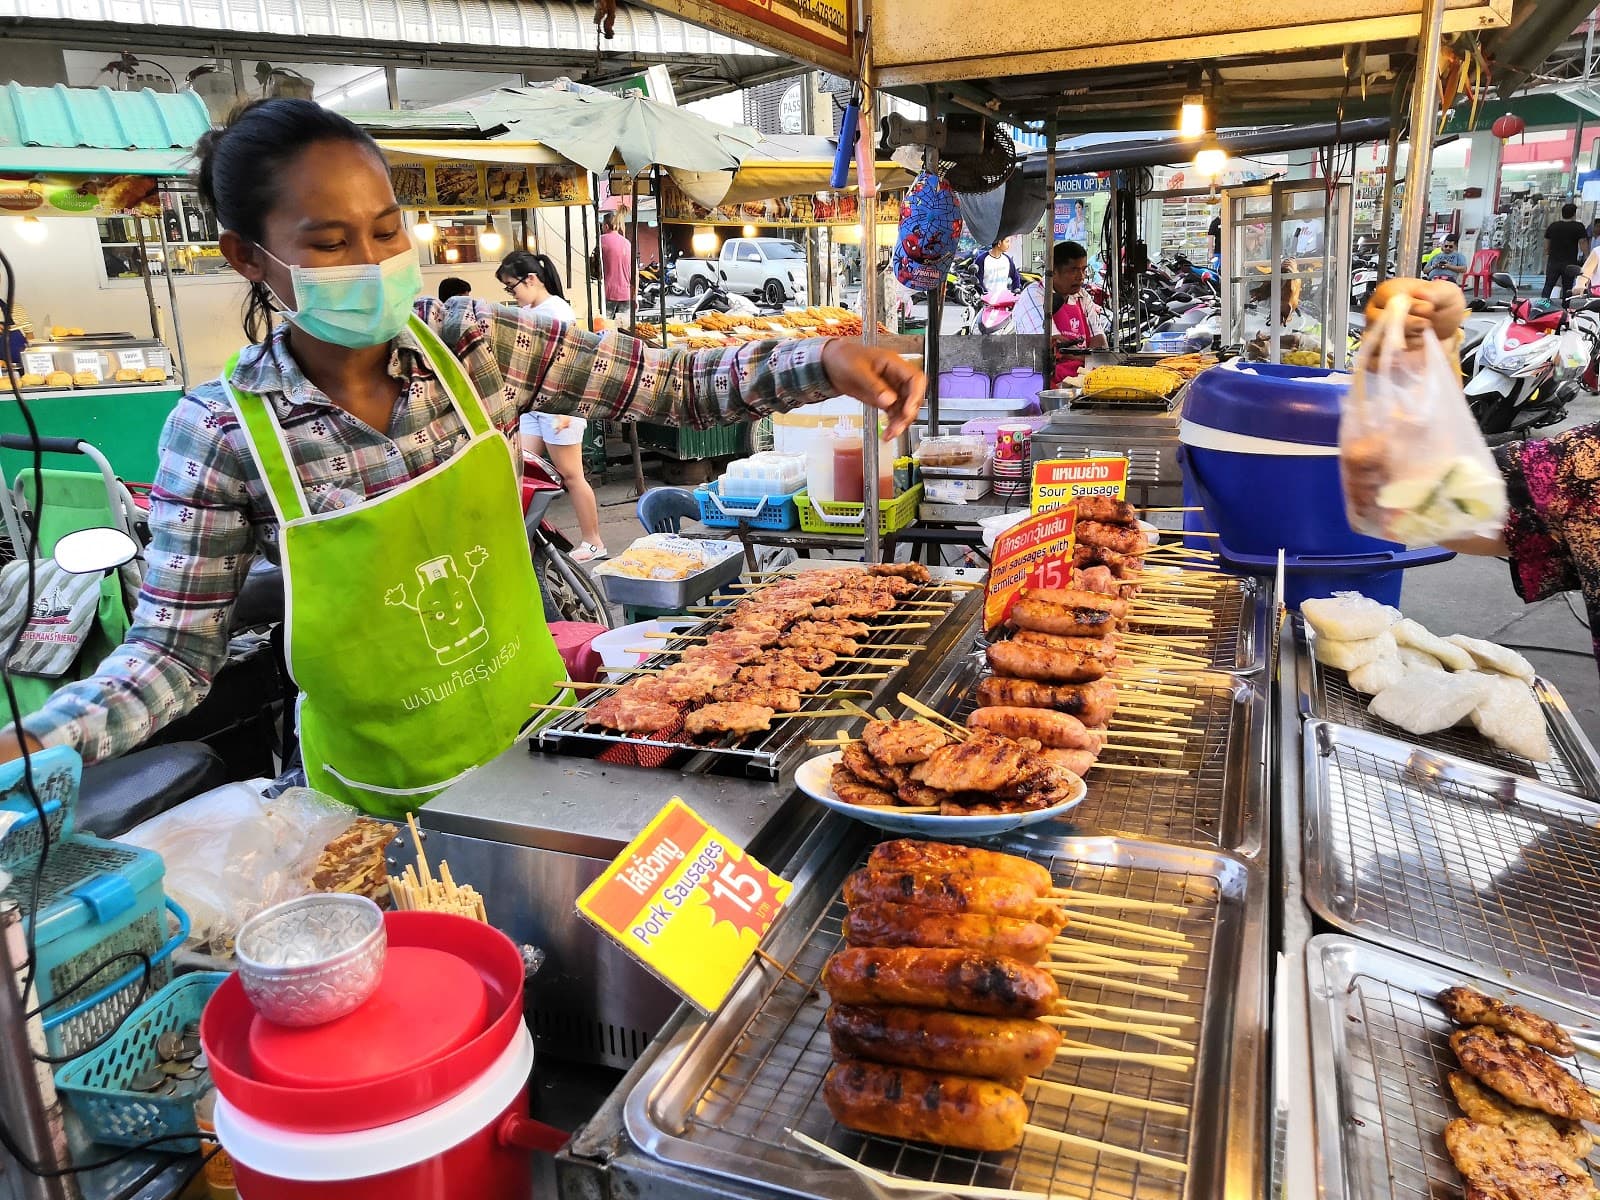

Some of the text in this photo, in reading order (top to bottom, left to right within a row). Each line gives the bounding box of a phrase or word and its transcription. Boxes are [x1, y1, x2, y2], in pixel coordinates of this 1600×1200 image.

[1052, 463, 1109, 481] แหนมย่าง
[1039, 484, 1120, 498] Sour Sausage
[993, 538, 1070, 578] Thai sausages with
[1034, 559, 1062, 590] 15
[54, 631, 78, 643] FRIEND
[615, 837, 686, 896] ไส้อั่วหมู
[632, 840, 723, 945] Pork Sausages
[712, 861, 763, 913] 15
